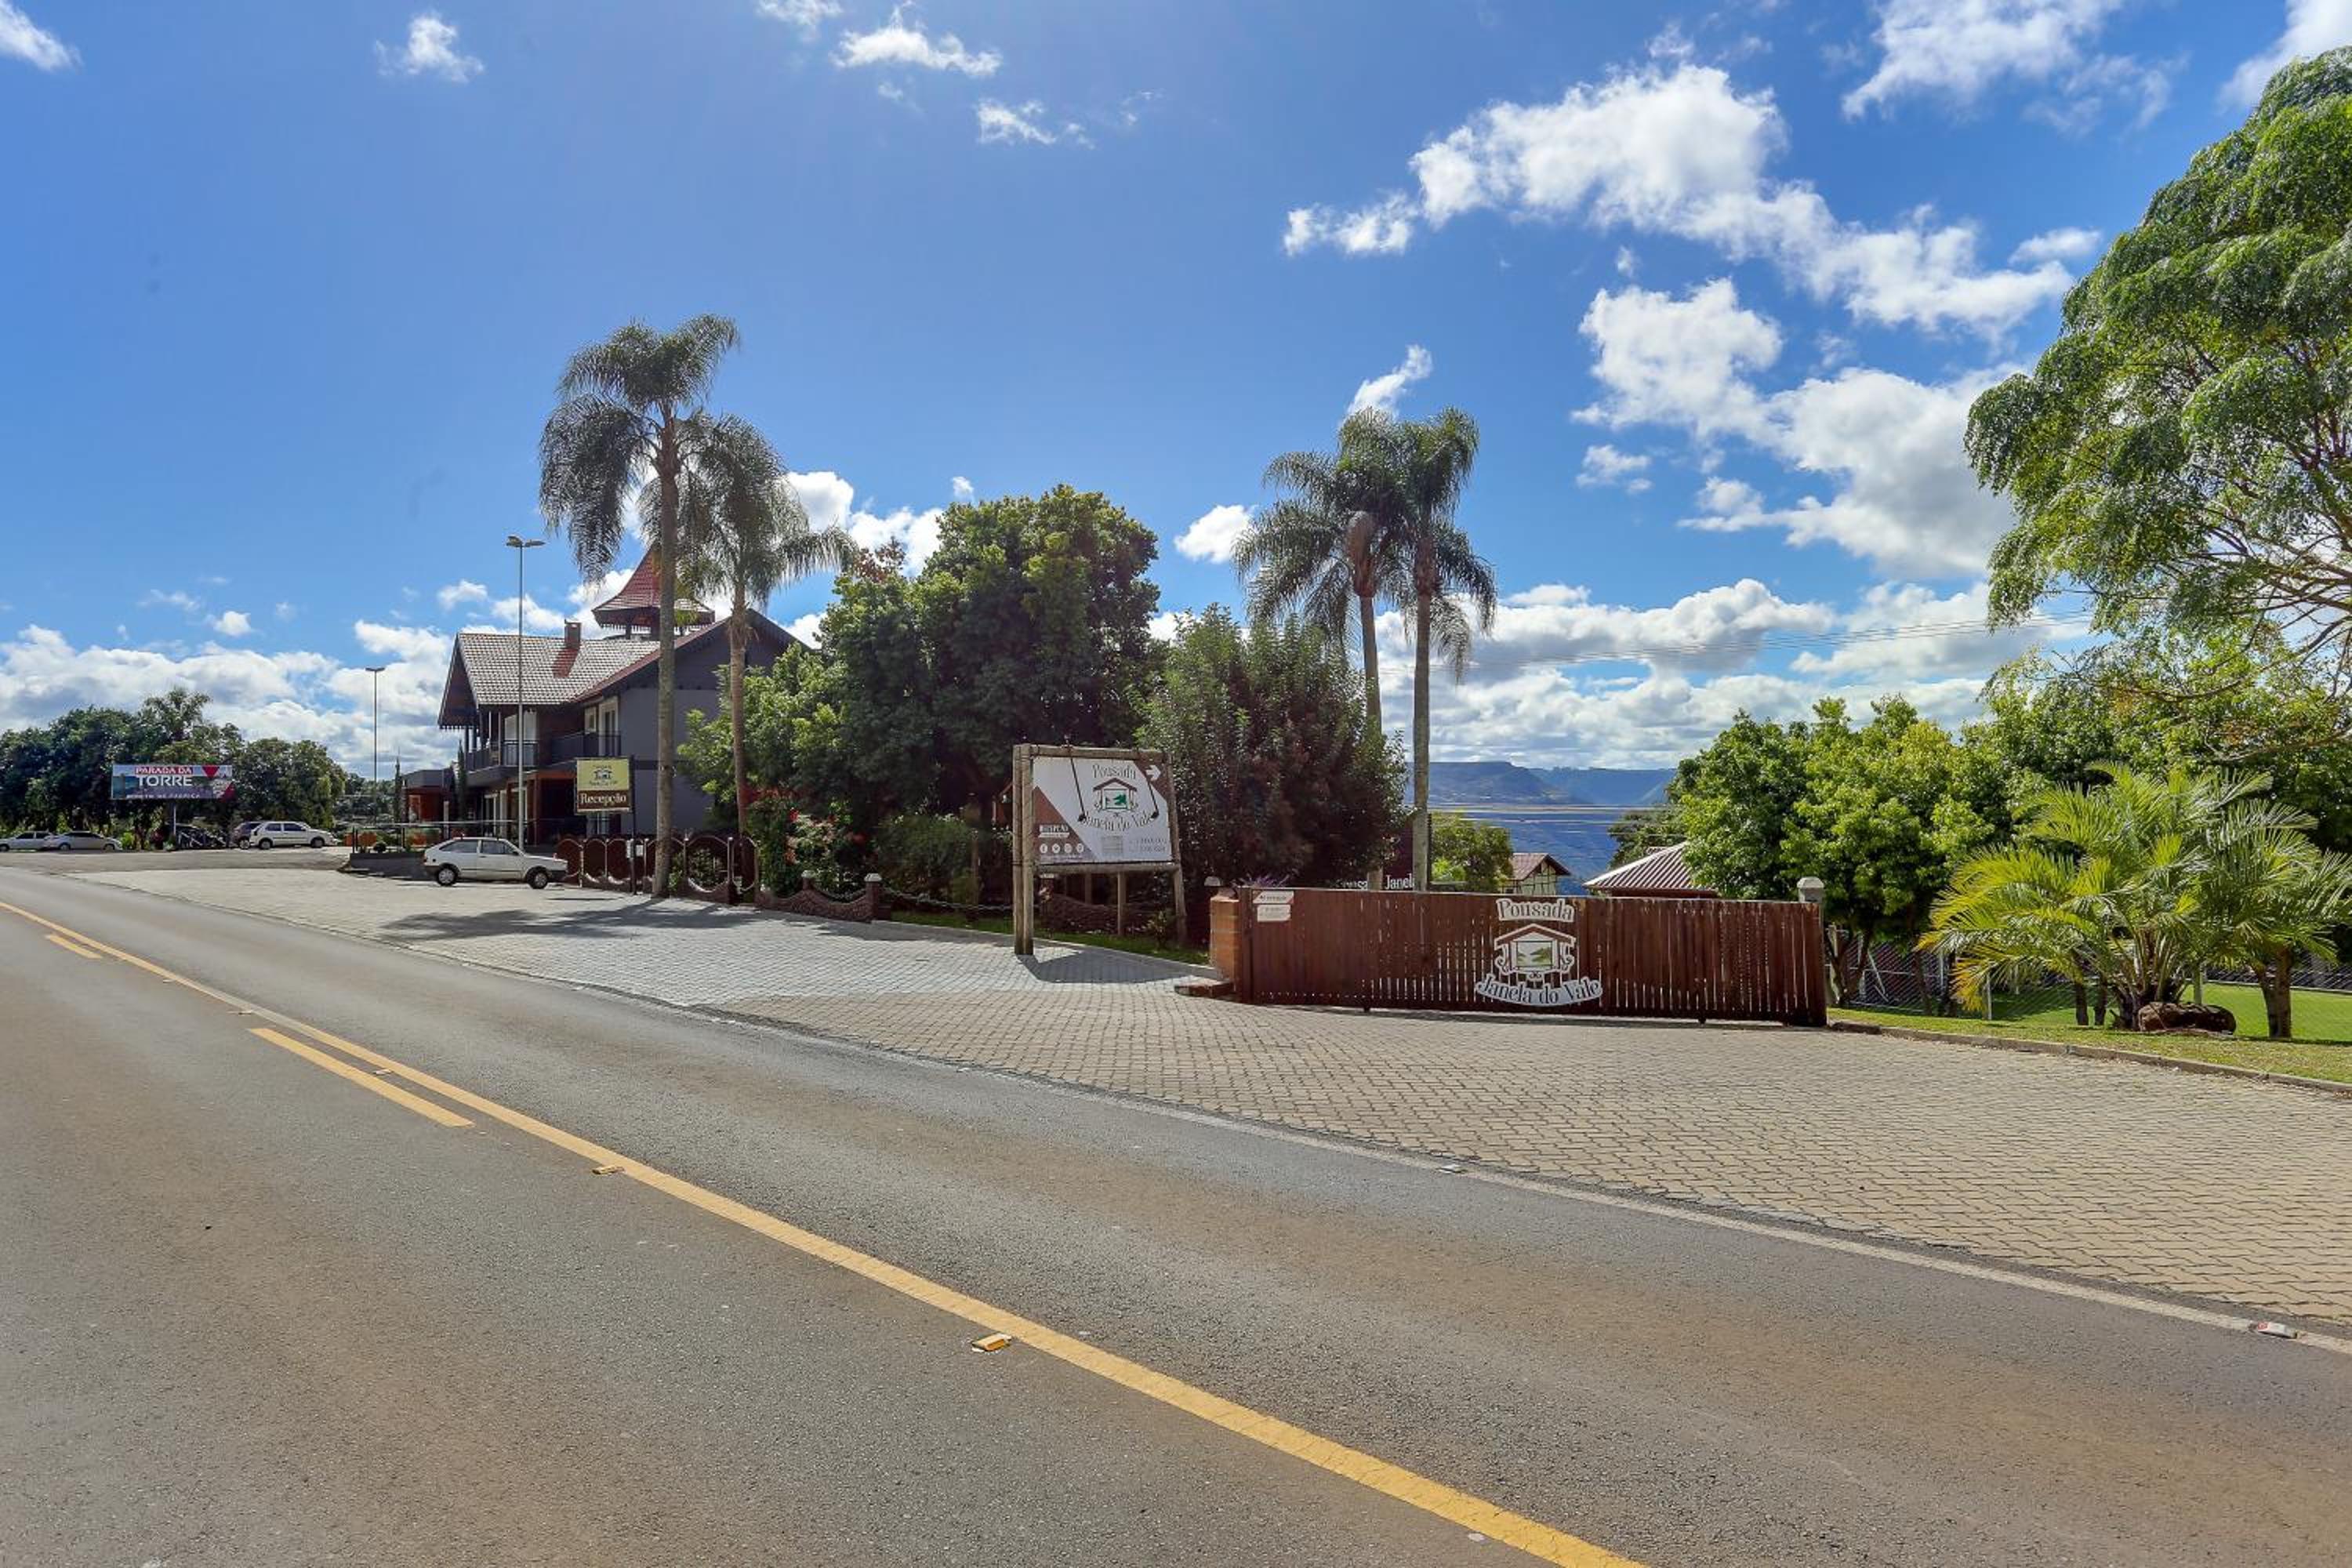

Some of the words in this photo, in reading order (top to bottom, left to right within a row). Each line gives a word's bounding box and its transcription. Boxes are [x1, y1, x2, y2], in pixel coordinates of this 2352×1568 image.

[178, 766, 192, 775] DA
[137, 775, 193, 786] TORRE
[580, 793, 626, 807] Recepção
[1497, 899, 1574, 920] Pousada
[1477, 975, 1532, 1004] Janela
[1539, 985, 1559, 1004] do
[1563, 978, 1599, 1001] Vale
